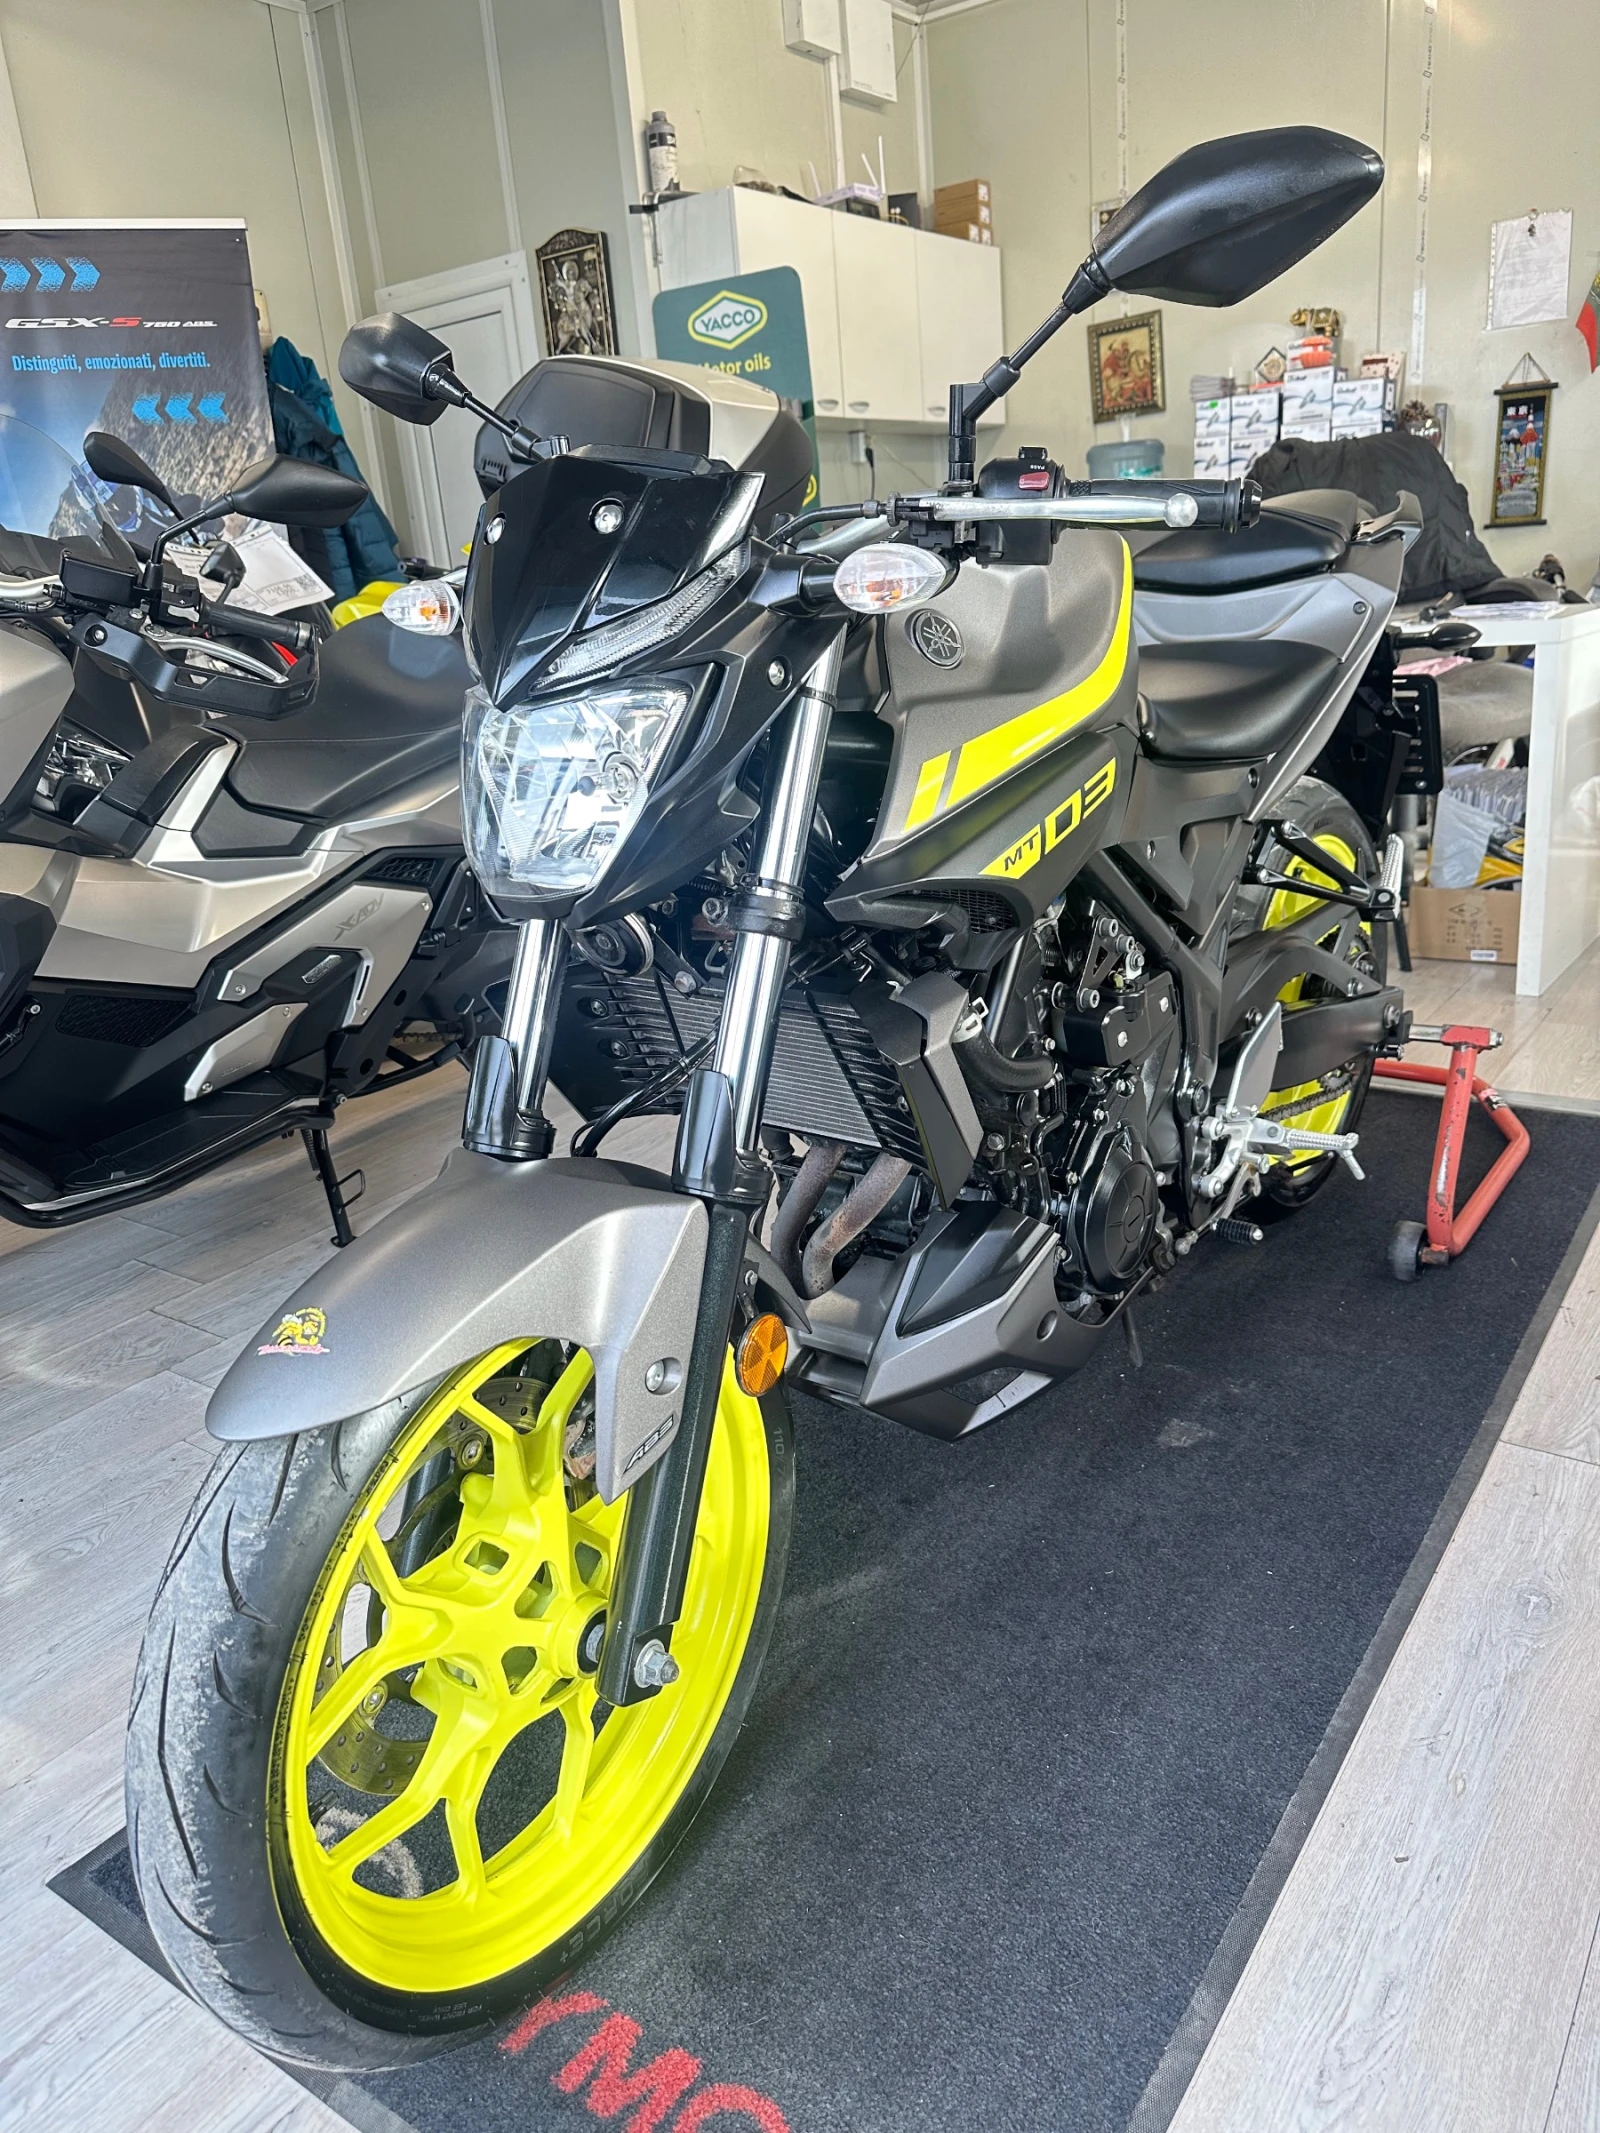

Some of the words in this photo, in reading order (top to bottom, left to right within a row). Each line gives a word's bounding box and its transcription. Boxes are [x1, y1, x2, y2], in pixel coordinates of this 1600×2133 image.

[5, 317, 142, 328] GSX-S
[701, 309, 755, 332] YACCO
[12, 354, 82, 374] Distinguiti,
[85, 353, 156, 371] emozionati,
[159, 352, 211, 369] divertiti.
[744, 352, 771, 372] oils
[1004, 832, 1038, 871] MT
[1044, 757, 1116, 855] 03
